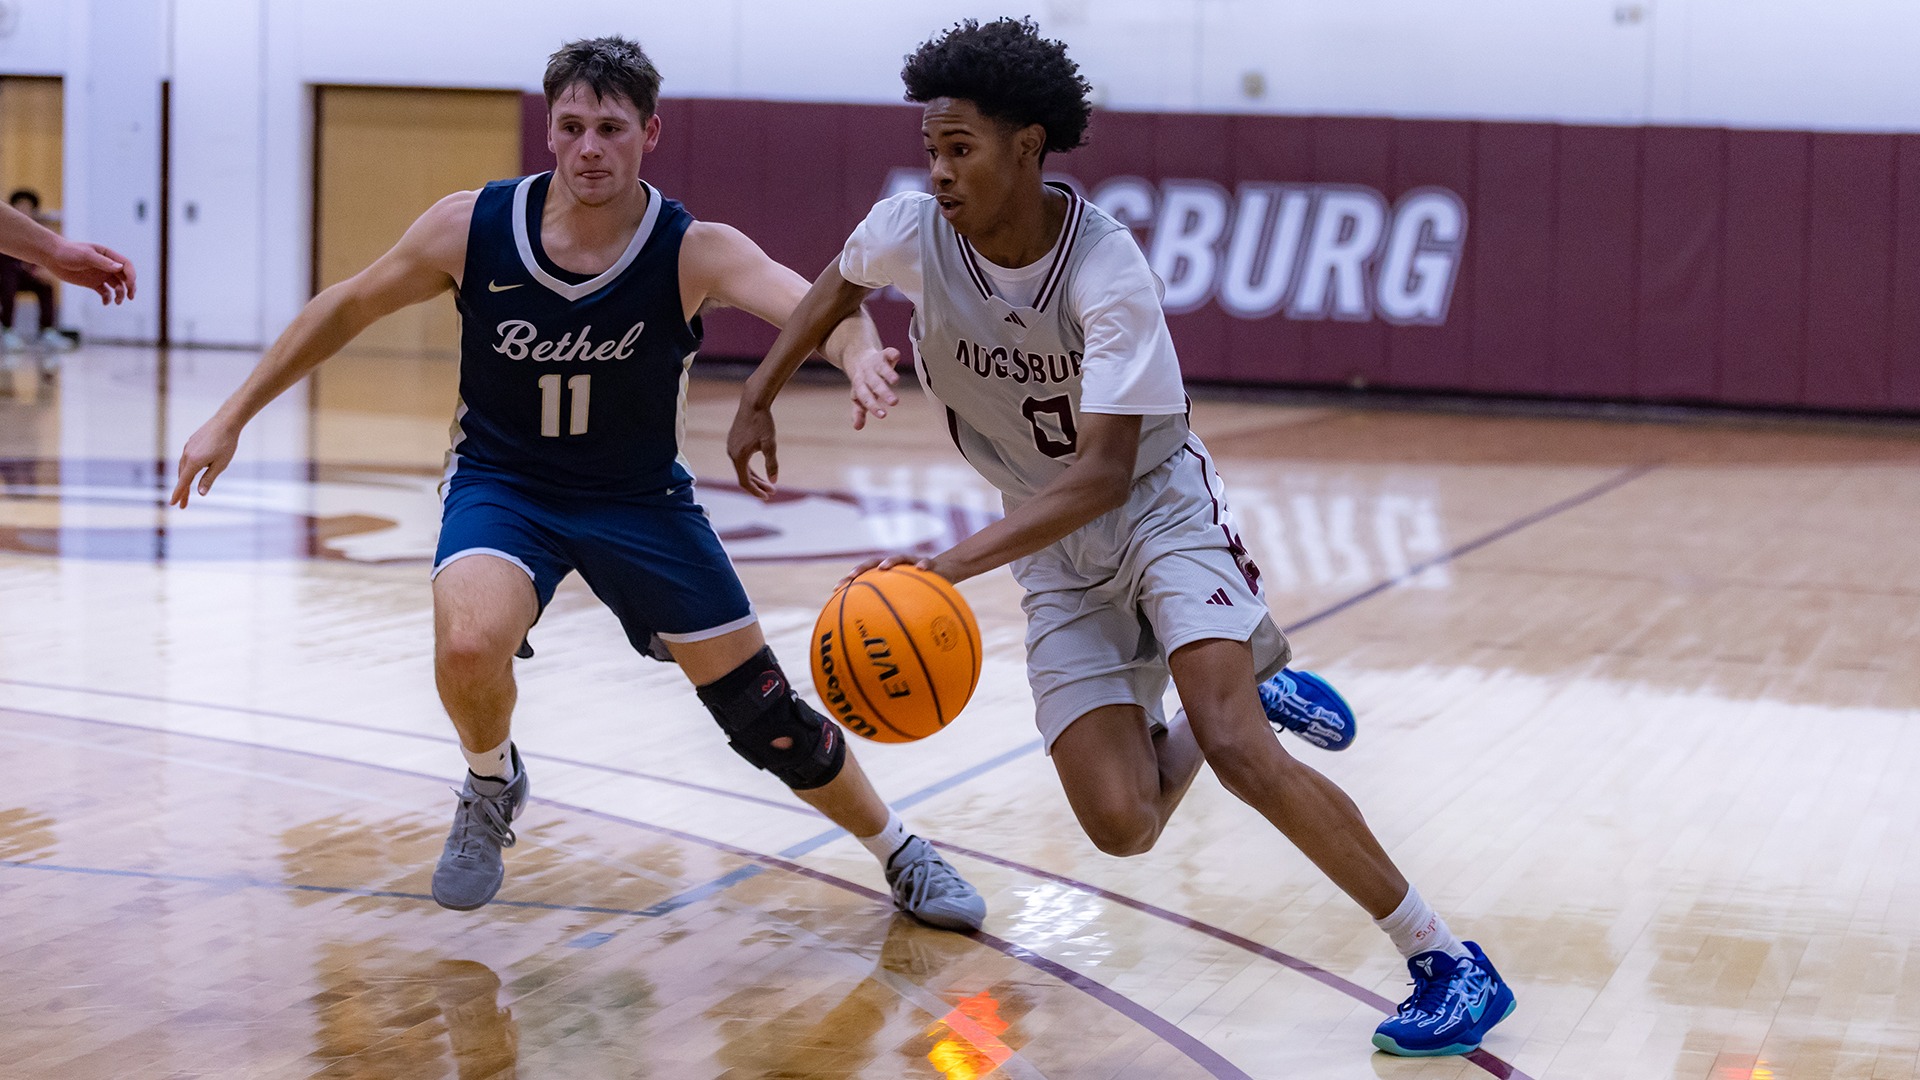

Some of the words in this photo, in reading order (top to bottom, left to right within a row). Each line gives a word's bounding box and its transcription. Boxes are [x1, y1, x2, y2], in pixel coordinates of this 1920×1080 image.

[866, 167, 1469, 326] BURG
[492, 319, 645, 362] Bethel
[955, 338, 1084, 384] AUGSBUR
[538, 374, 591, 437] 11
[1021, 391, 1078, 459] 0
[820, 630, 878, 738] Wilson
[864, 636, 911, 699] EVO
